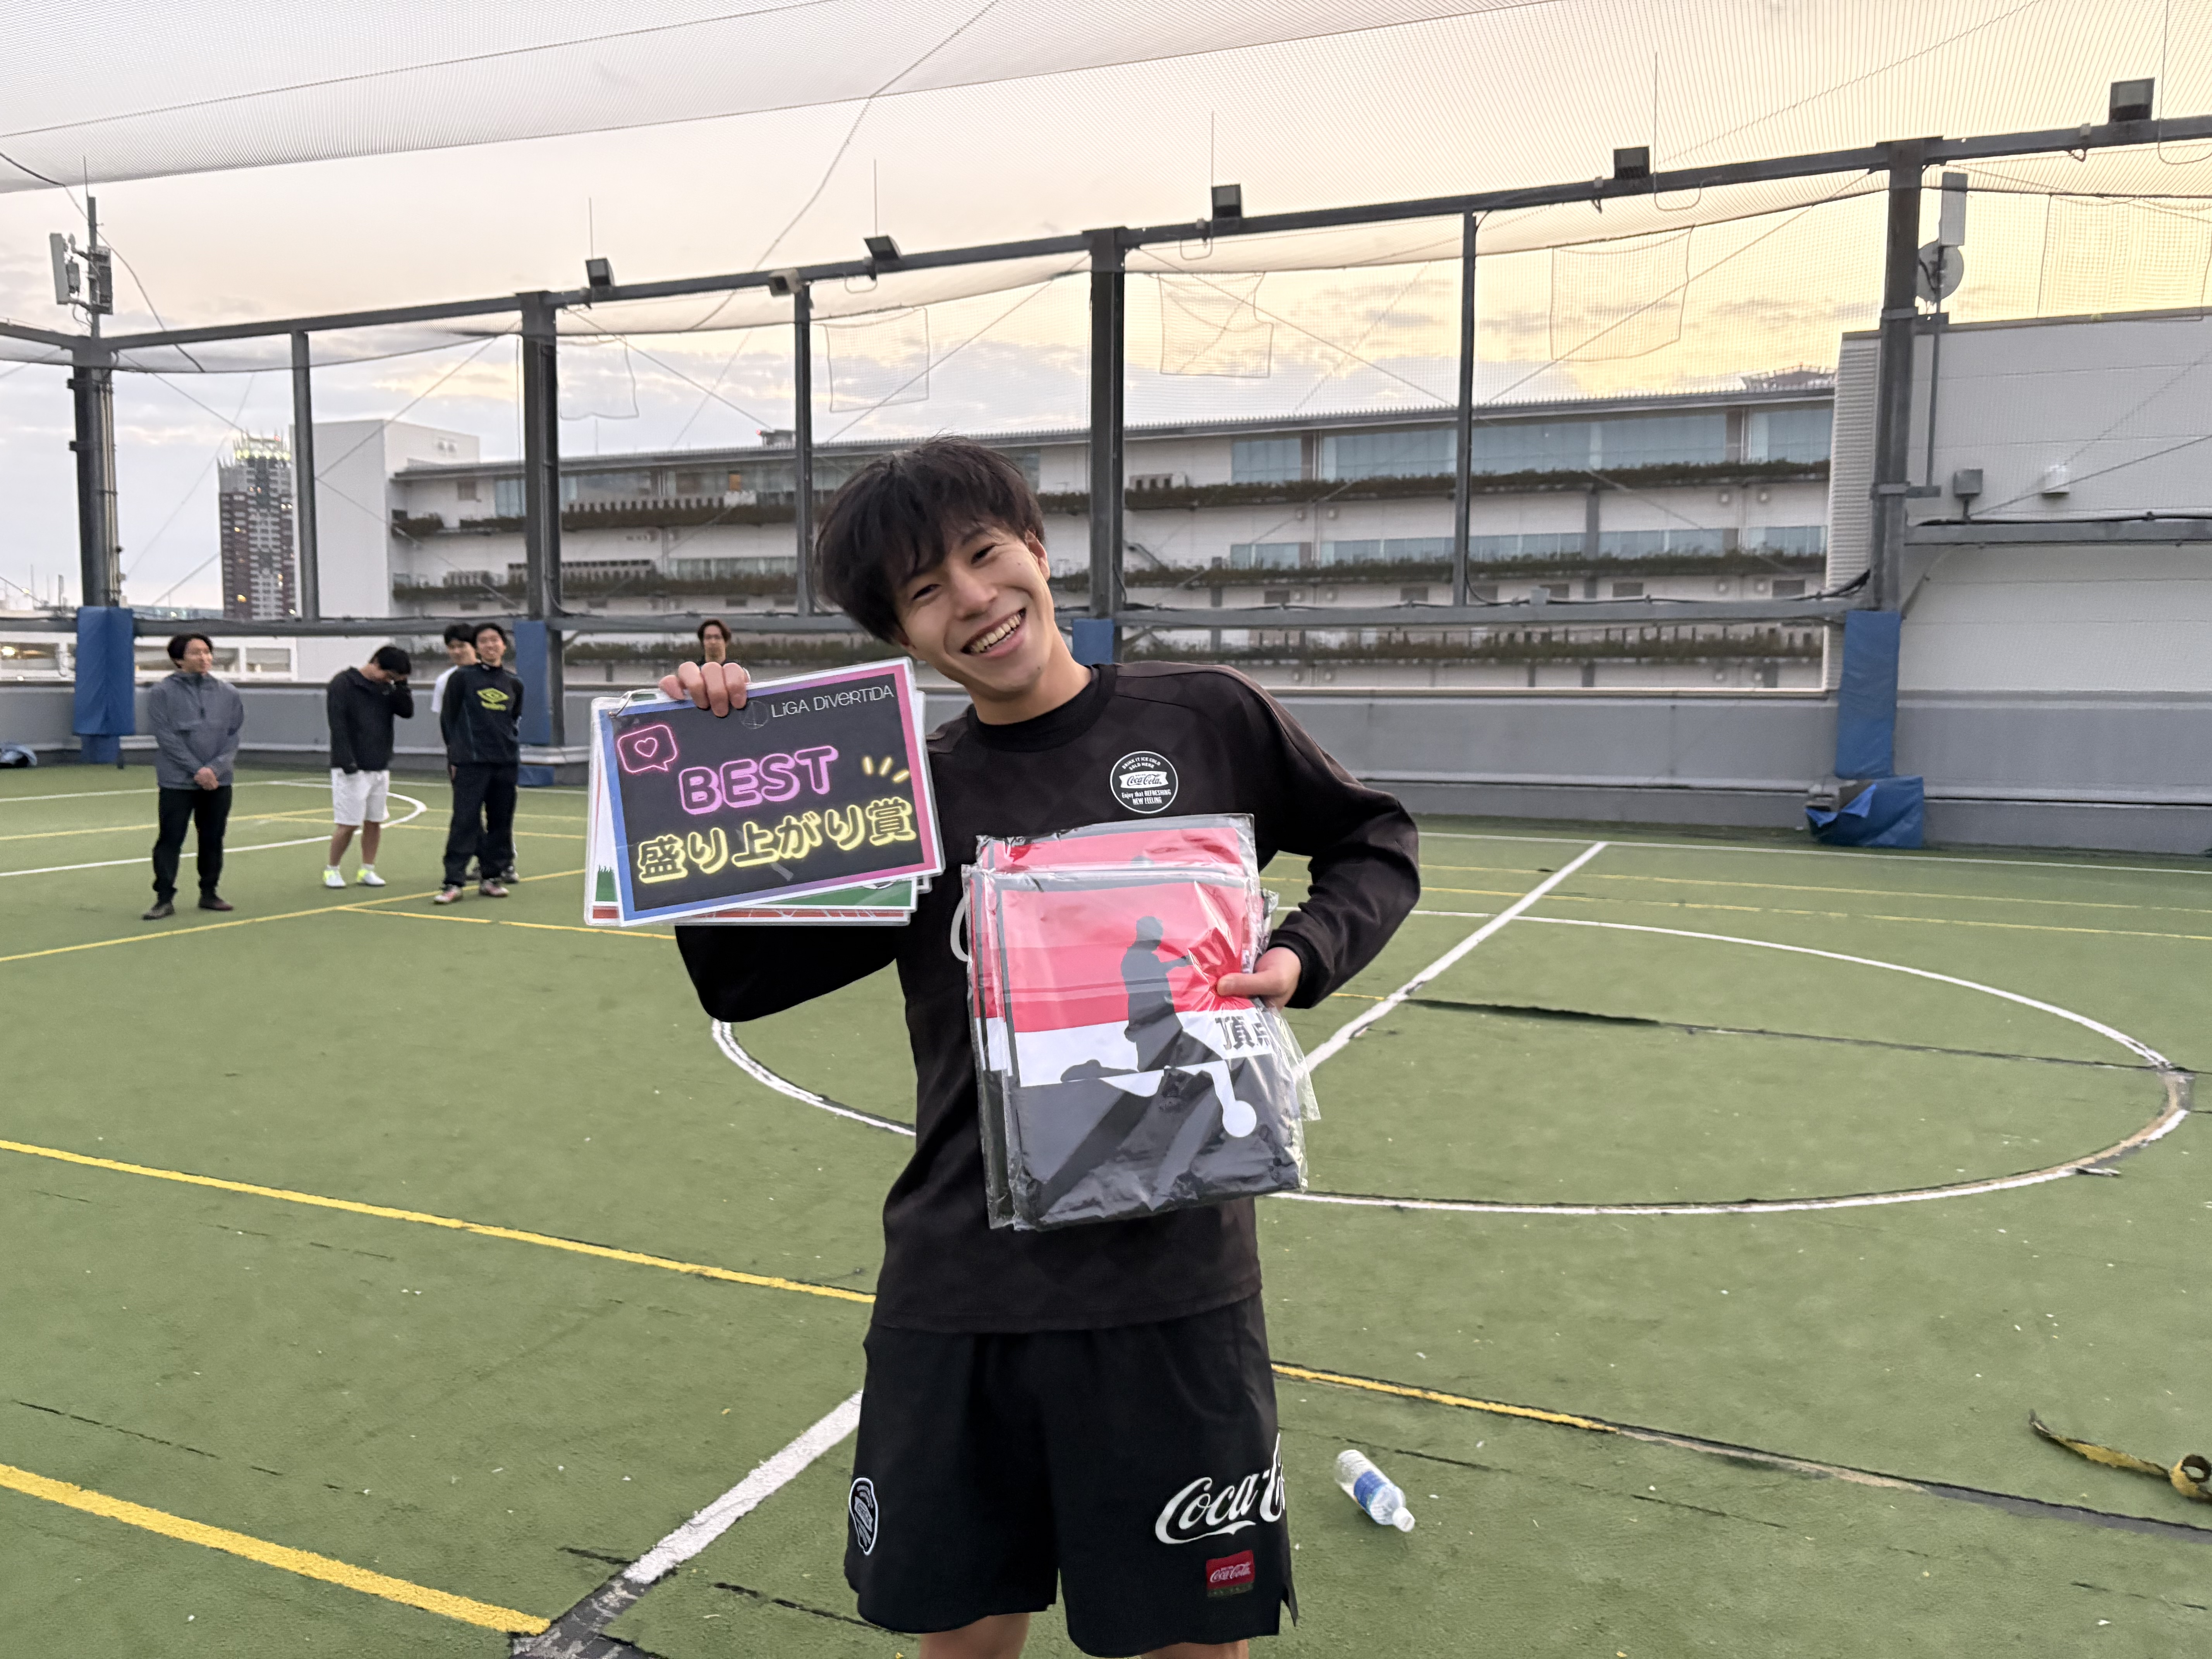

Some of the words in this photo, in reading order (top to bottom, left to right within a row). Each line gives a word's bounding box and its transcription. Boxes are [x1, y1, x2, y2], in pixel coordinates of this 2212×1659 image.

[678, 745, 838, 815] BEST
[638, 796, 917, 884] 盛り上がり賞
